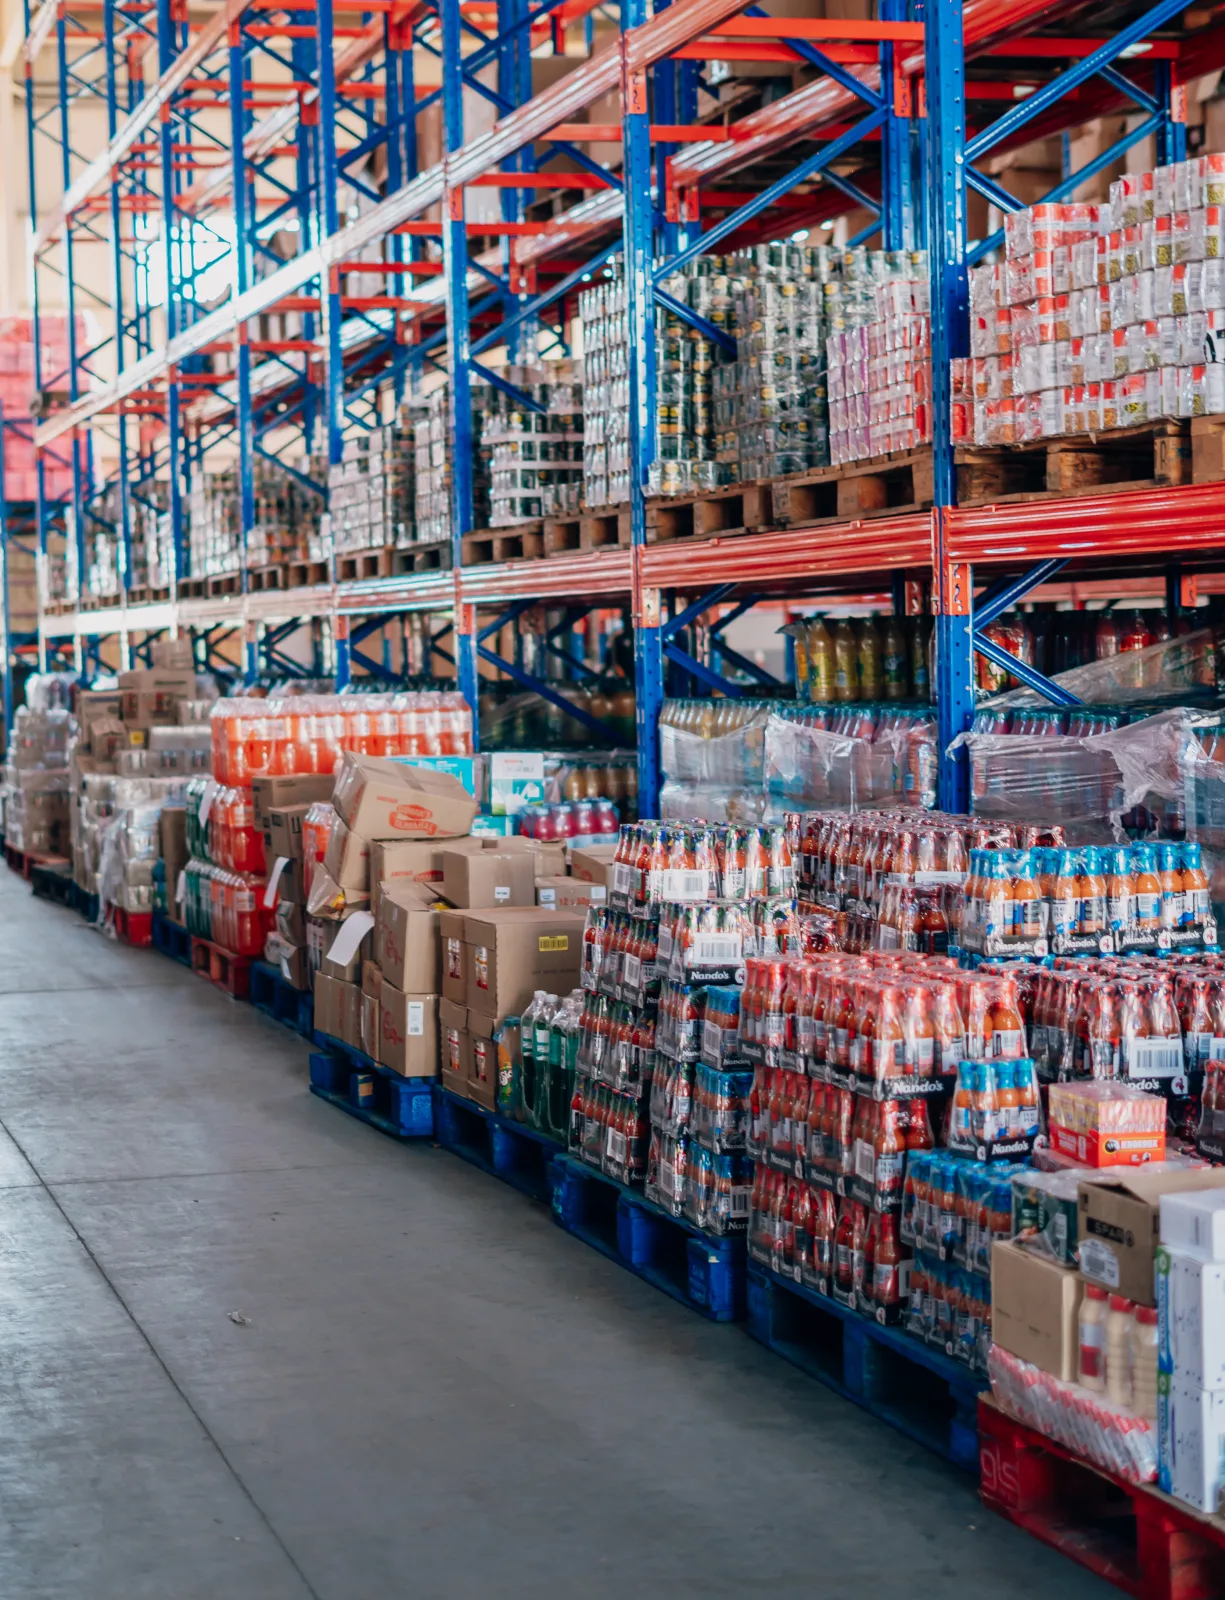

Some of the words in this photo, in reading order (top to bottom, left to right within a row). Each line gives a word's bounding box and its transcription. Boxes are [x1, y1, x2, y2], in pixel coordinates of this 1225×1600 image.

[690, 970, 730, 981] Nando's
[892, 1080, 945, 1094] Nando's
[992, 1139, 1030, 1155] Nando's
[1095, 1222, 1123, 1240] SPAR
[980, 1443, 1020, 1492] gls
